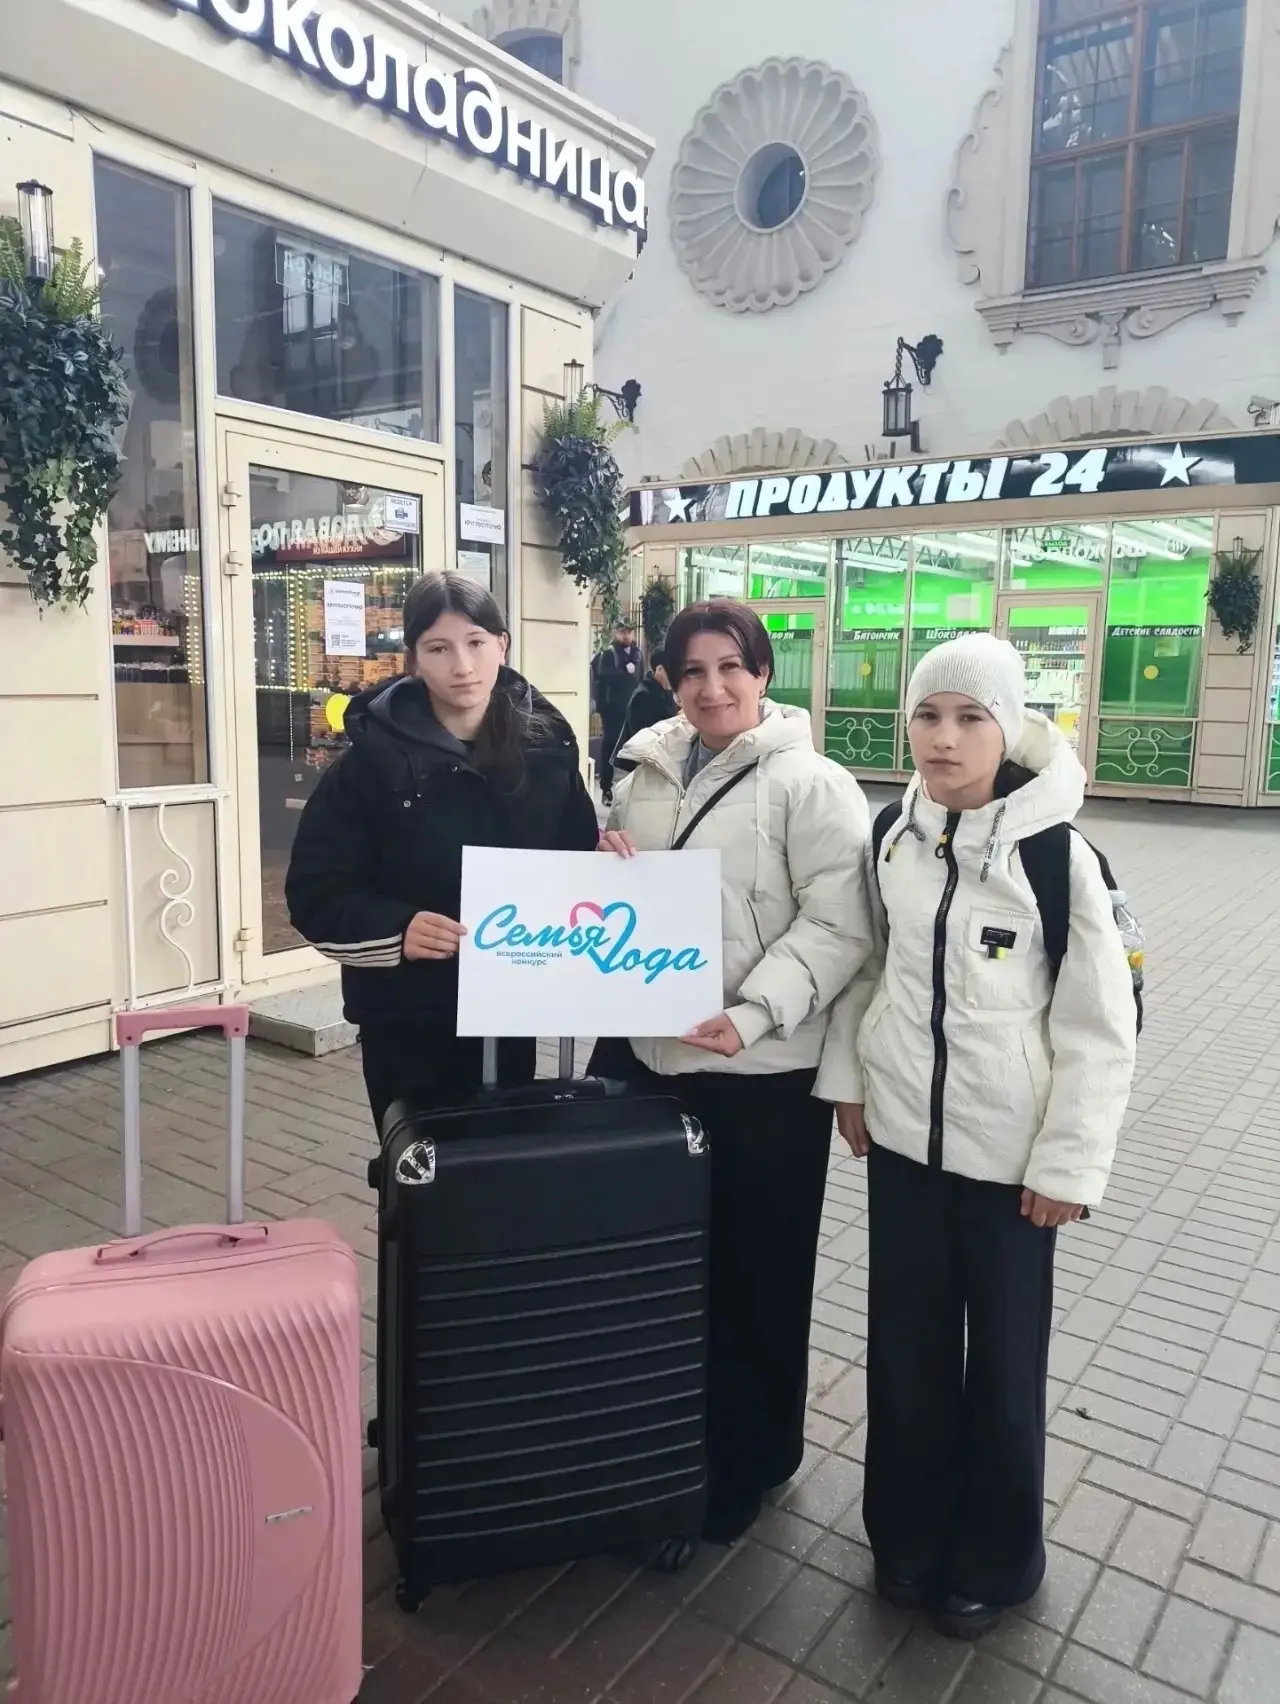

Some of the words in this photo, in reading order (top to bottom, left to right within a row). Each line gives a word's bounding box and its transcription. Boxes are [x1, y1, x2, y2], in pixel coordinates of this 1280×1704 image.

[724, 456, 1008, 519] ПРОДУКТЫ
[1029, 448, 1107, 497] 24
[474, 902, 612, 957] Семья
[496, 950, 563, 959] всероссийский
[511, 959, 548, 968] конкурс
